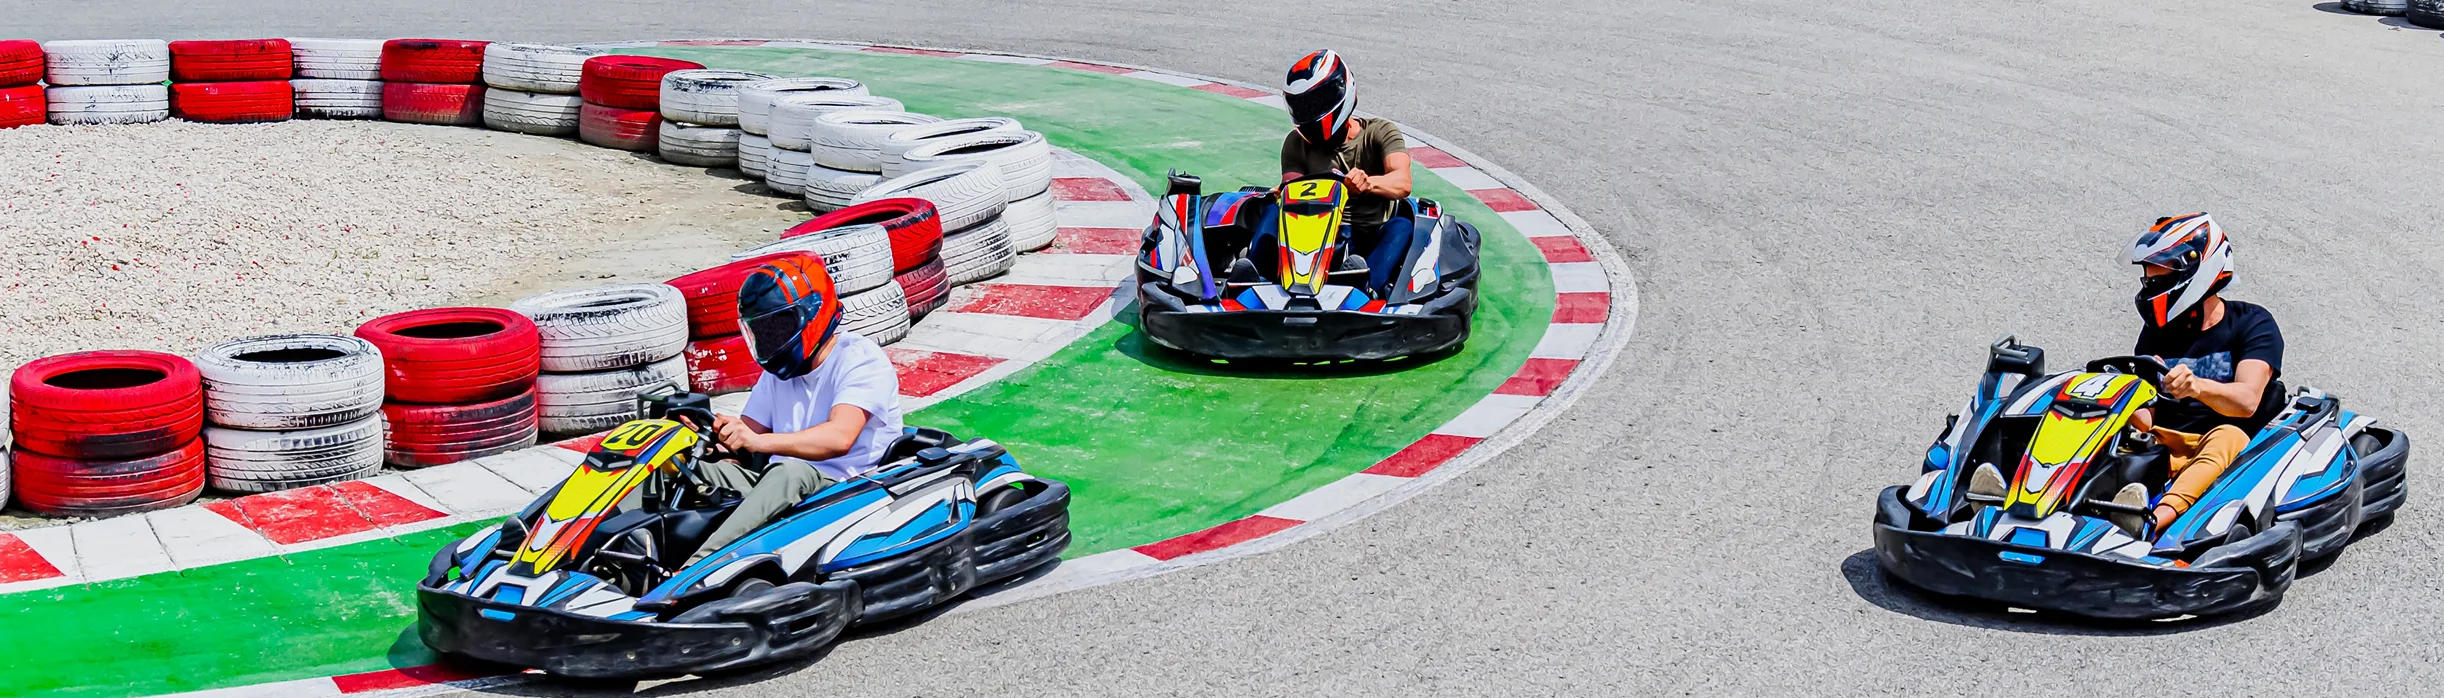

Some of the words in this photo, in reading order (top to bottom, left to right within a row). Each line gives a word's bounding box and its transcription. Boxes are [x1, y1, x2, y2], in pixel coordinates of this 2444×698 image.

[1300, 182, 1317, 197] 2
[2070, 373, 2118, 398] 4
[604, 423, 663, 446] 20
